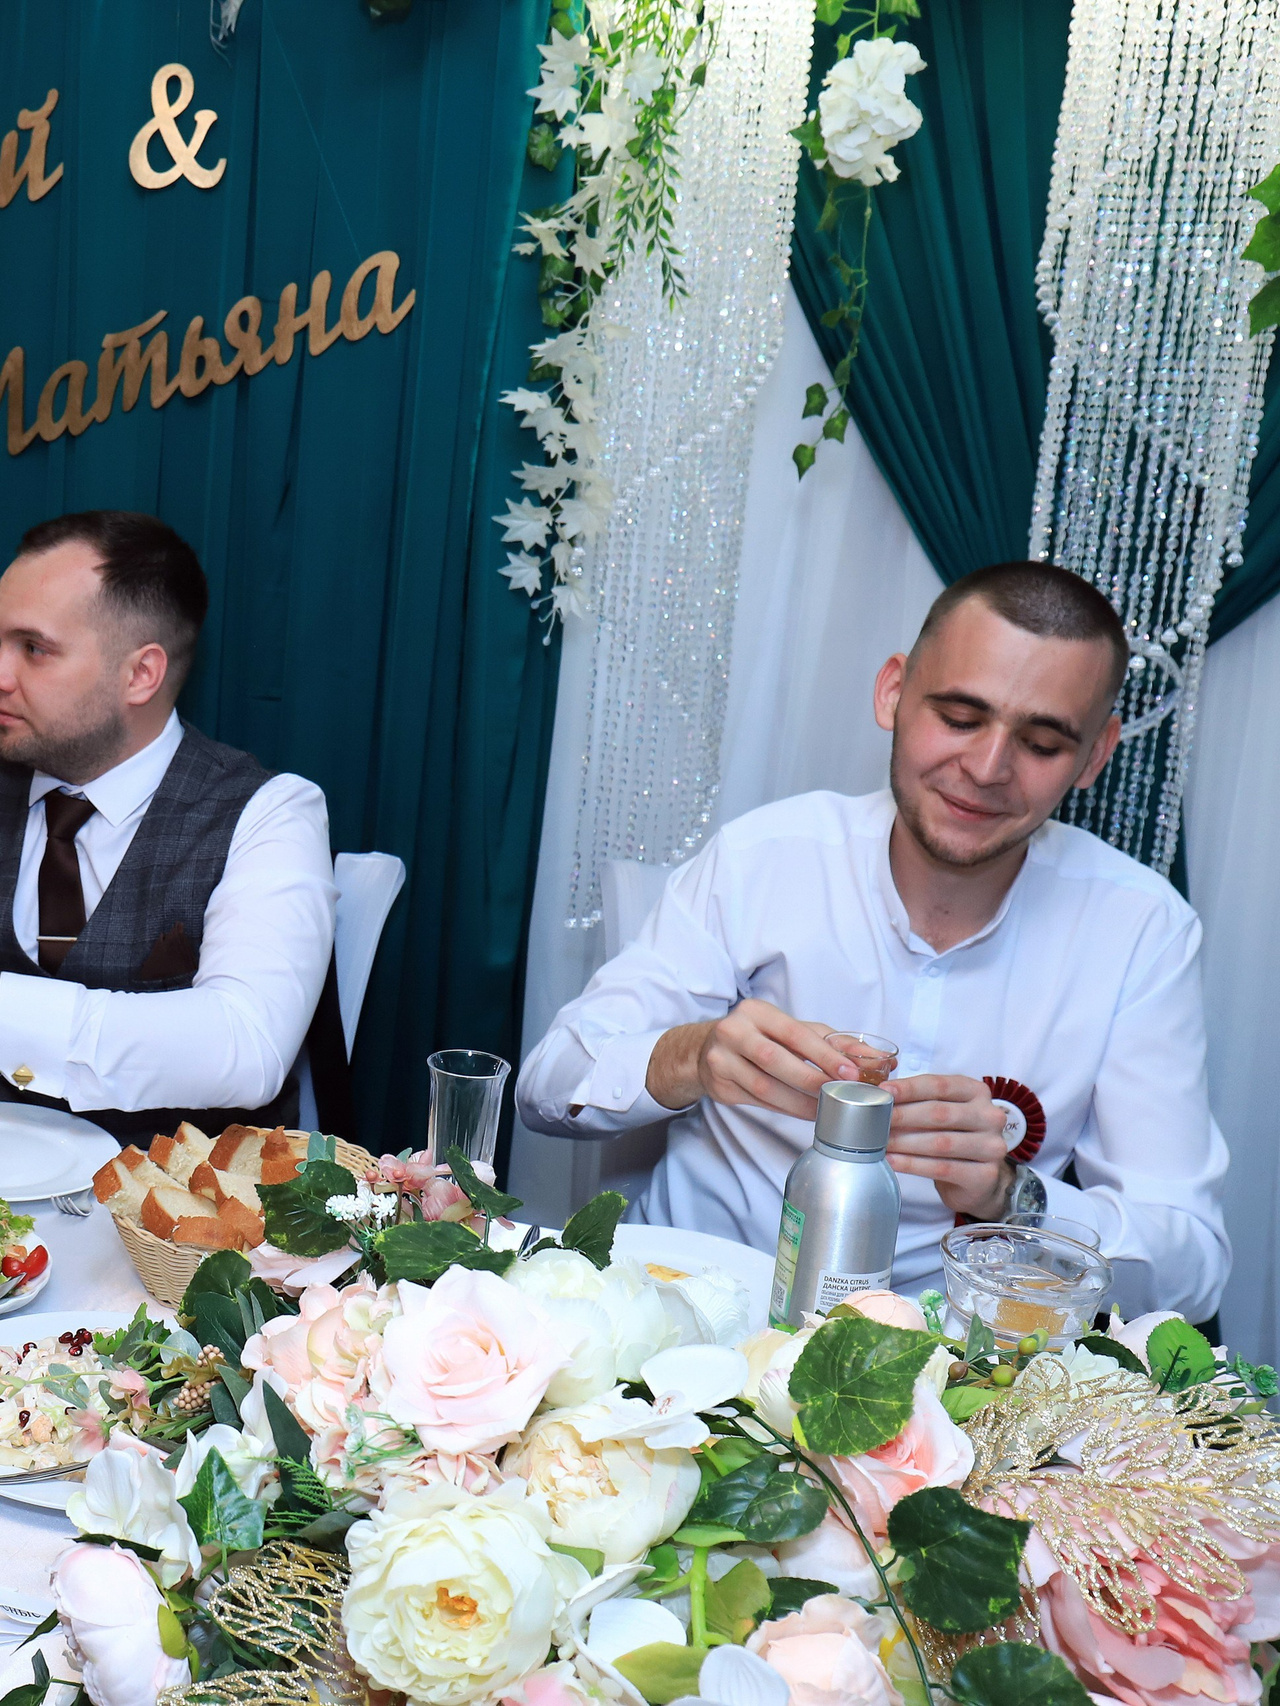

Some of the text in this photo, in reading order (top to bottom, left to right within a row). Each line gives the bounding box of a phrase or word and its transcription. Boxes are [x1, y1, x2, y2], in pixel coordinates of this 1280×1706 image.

[129, 63, 227, 189] &
[823, 1276, 849, 1285] DANZKA
[822, 1283, 849, 1292] ДАНСКА
